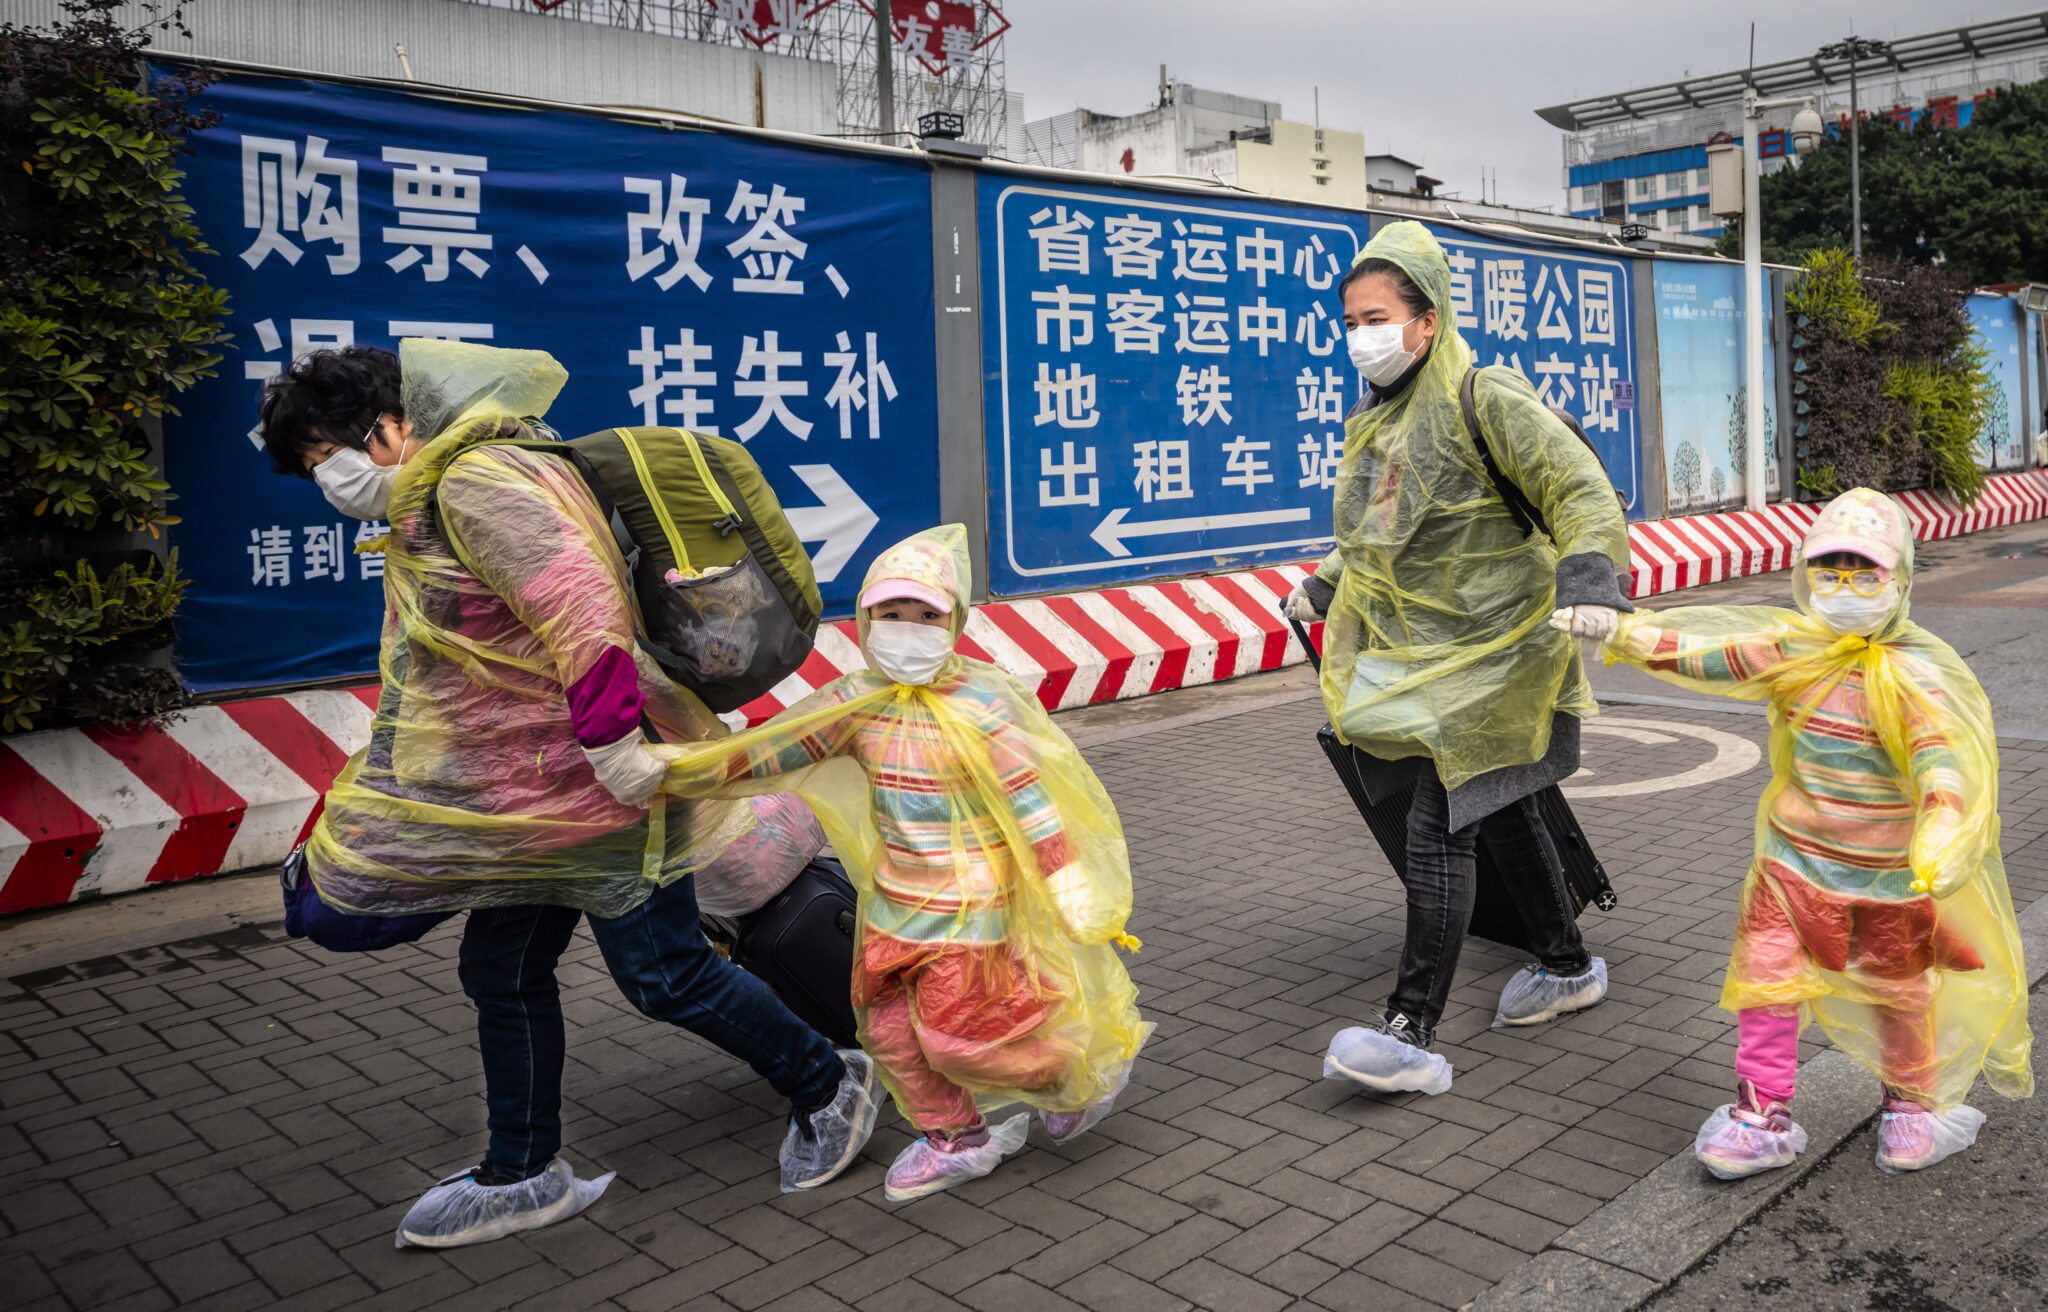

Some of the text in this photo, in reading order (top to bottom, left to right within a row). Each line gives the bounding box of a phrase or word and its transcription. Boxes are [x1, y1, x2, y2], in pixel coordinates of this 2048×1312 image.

[898, 15, 976, 70] 友善
[1028, 206, 1341, 290] 省客运中心
[1032, 285, 1344, 358] 市客运中心
[628, 326, 898, 442] 挂失补
